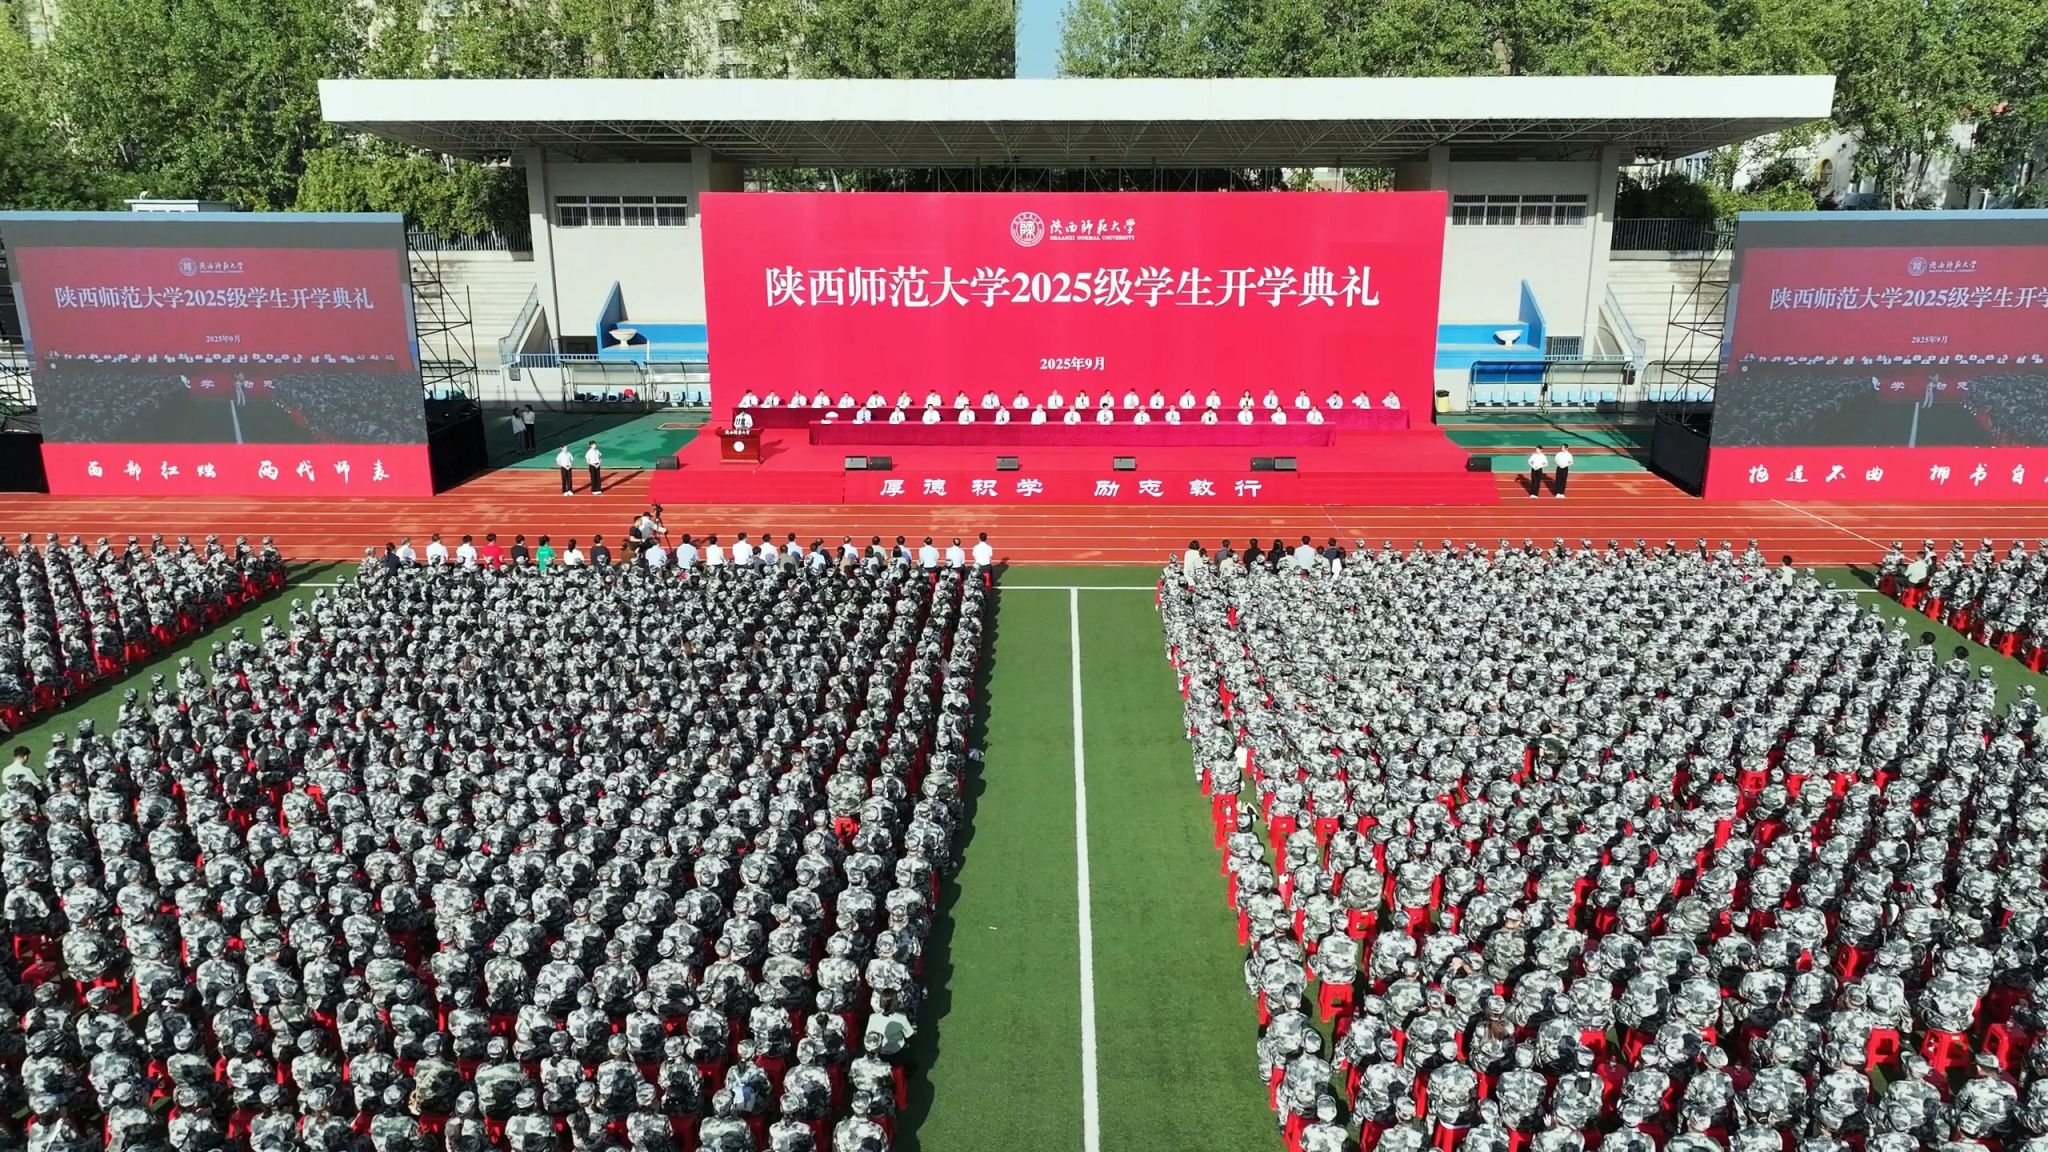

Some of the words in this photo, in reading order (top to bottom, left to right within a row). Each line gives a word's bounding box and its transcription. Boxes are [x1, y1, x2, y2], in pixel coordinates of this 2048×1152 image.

[54, 285, 374, 310] 陕西师范大学2025级学生开学典礼
[765, 265, 1380, 308] 陕西师范大学2025级学生开学典礼
[1911, 335, 1948, 344] 2025年9月
[1040, 356, 1105, 371] 2025年9月
[258, 459, 390, 483] 两代师表
[1930, 463, 2048, 486] 拥书自
[880, 478, 1043, 497] 厚德积学
[1094, 479, 1262, 497] 励志敦行
